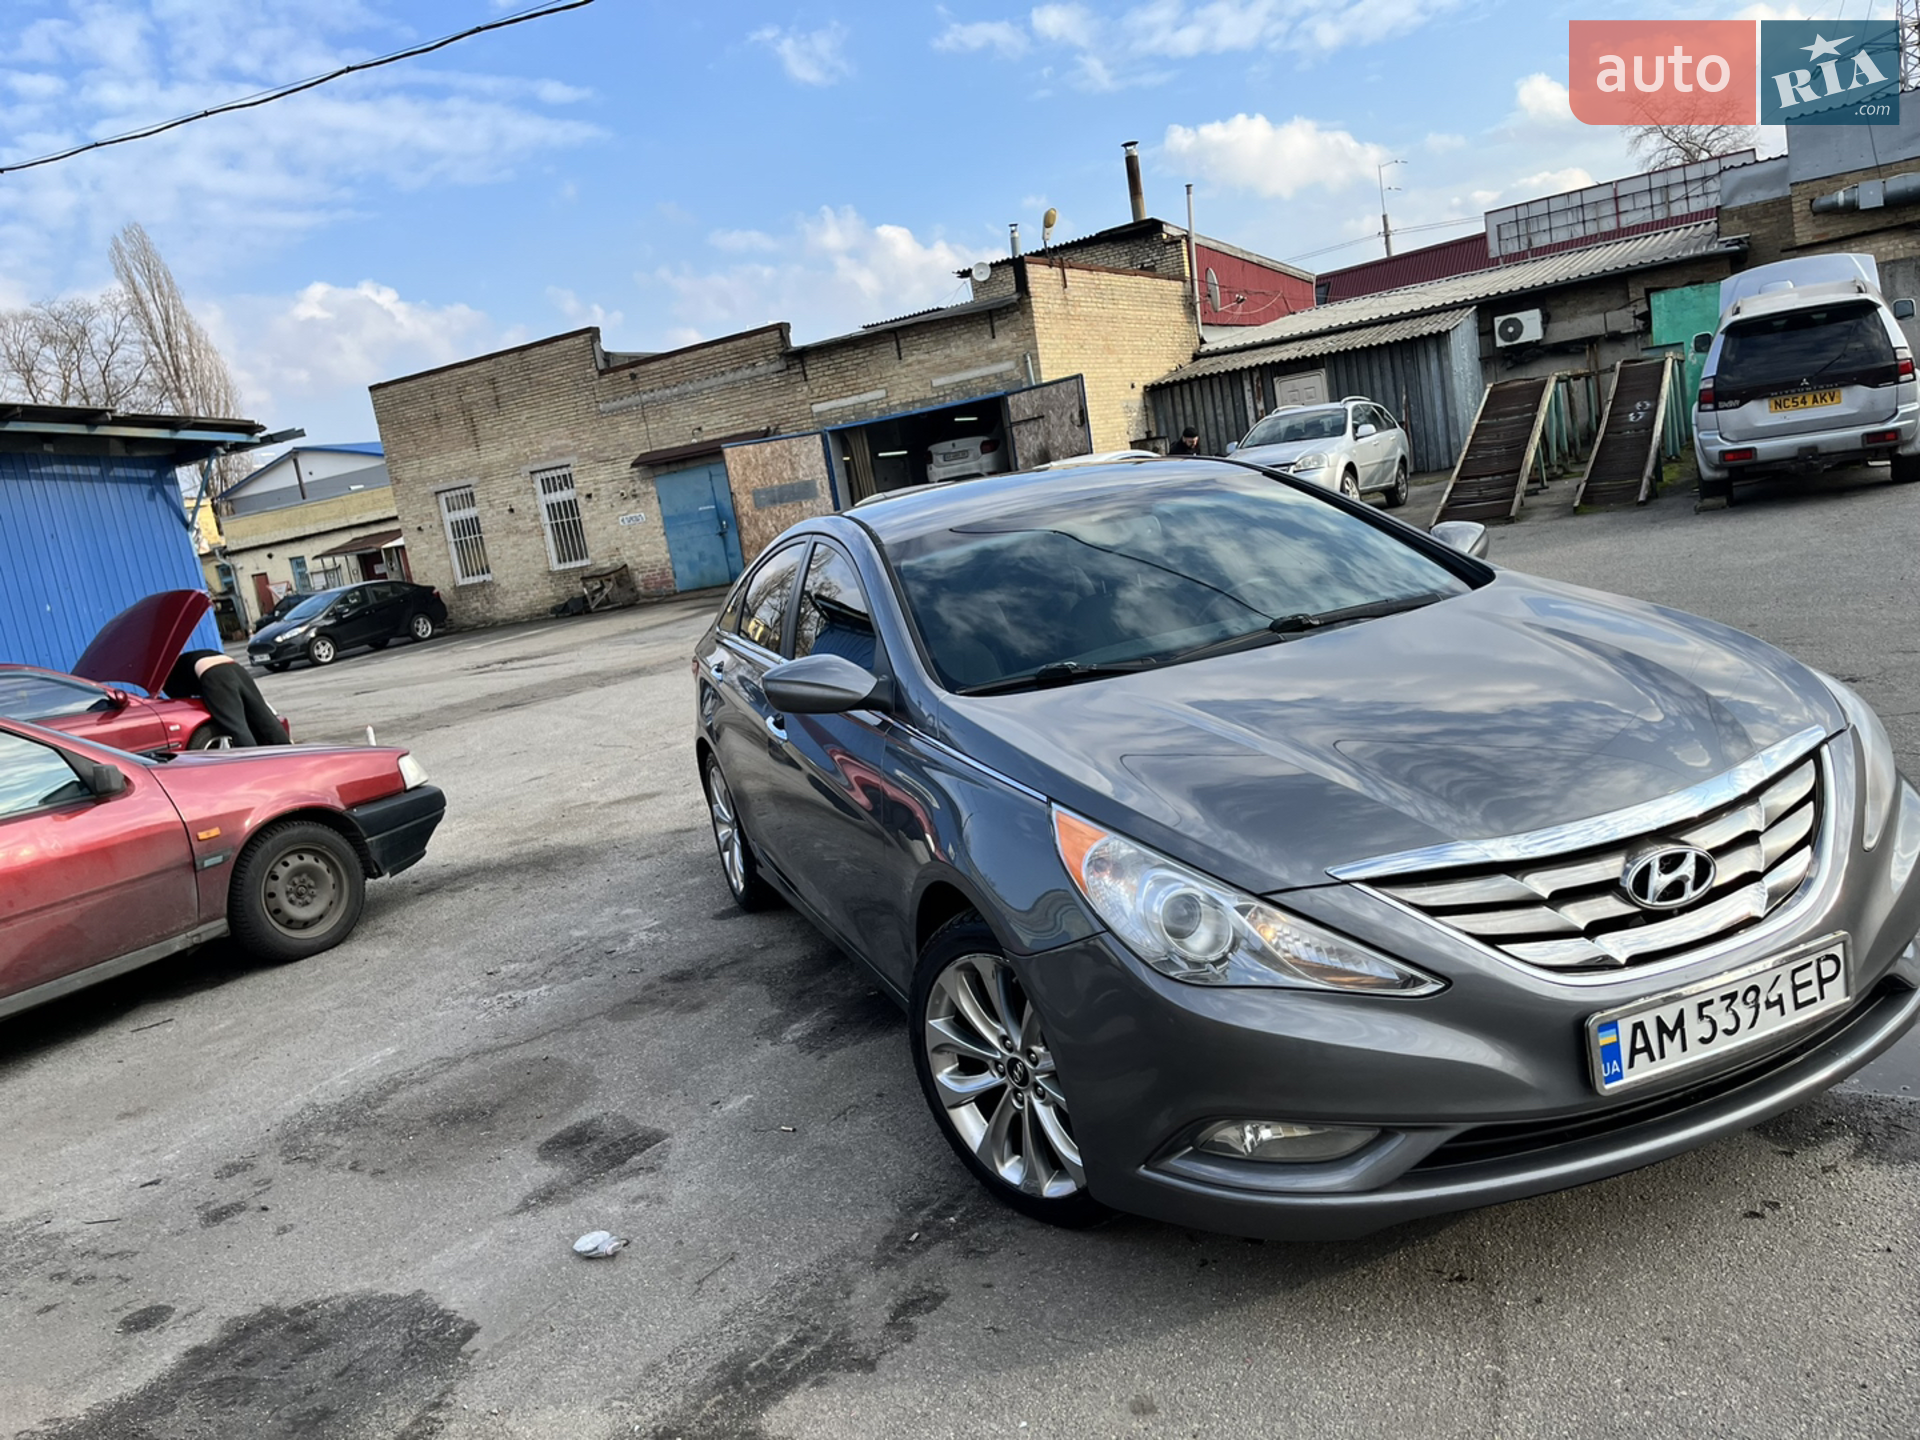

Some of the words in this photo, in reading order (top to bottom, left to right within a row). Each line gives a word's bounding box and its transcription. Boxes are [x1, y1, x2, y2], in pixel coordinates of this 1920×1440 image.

[1774, 395, 1807, 410] NC54
[1811, 391, 1836, 405] AKV
[1628, 1008, 1688, 1070] AM
[1697, 974, 1786, 1045] 5394
[1790, 953, 1841, 1011] EP
[1602, 1060, 1621, 1077] UA
